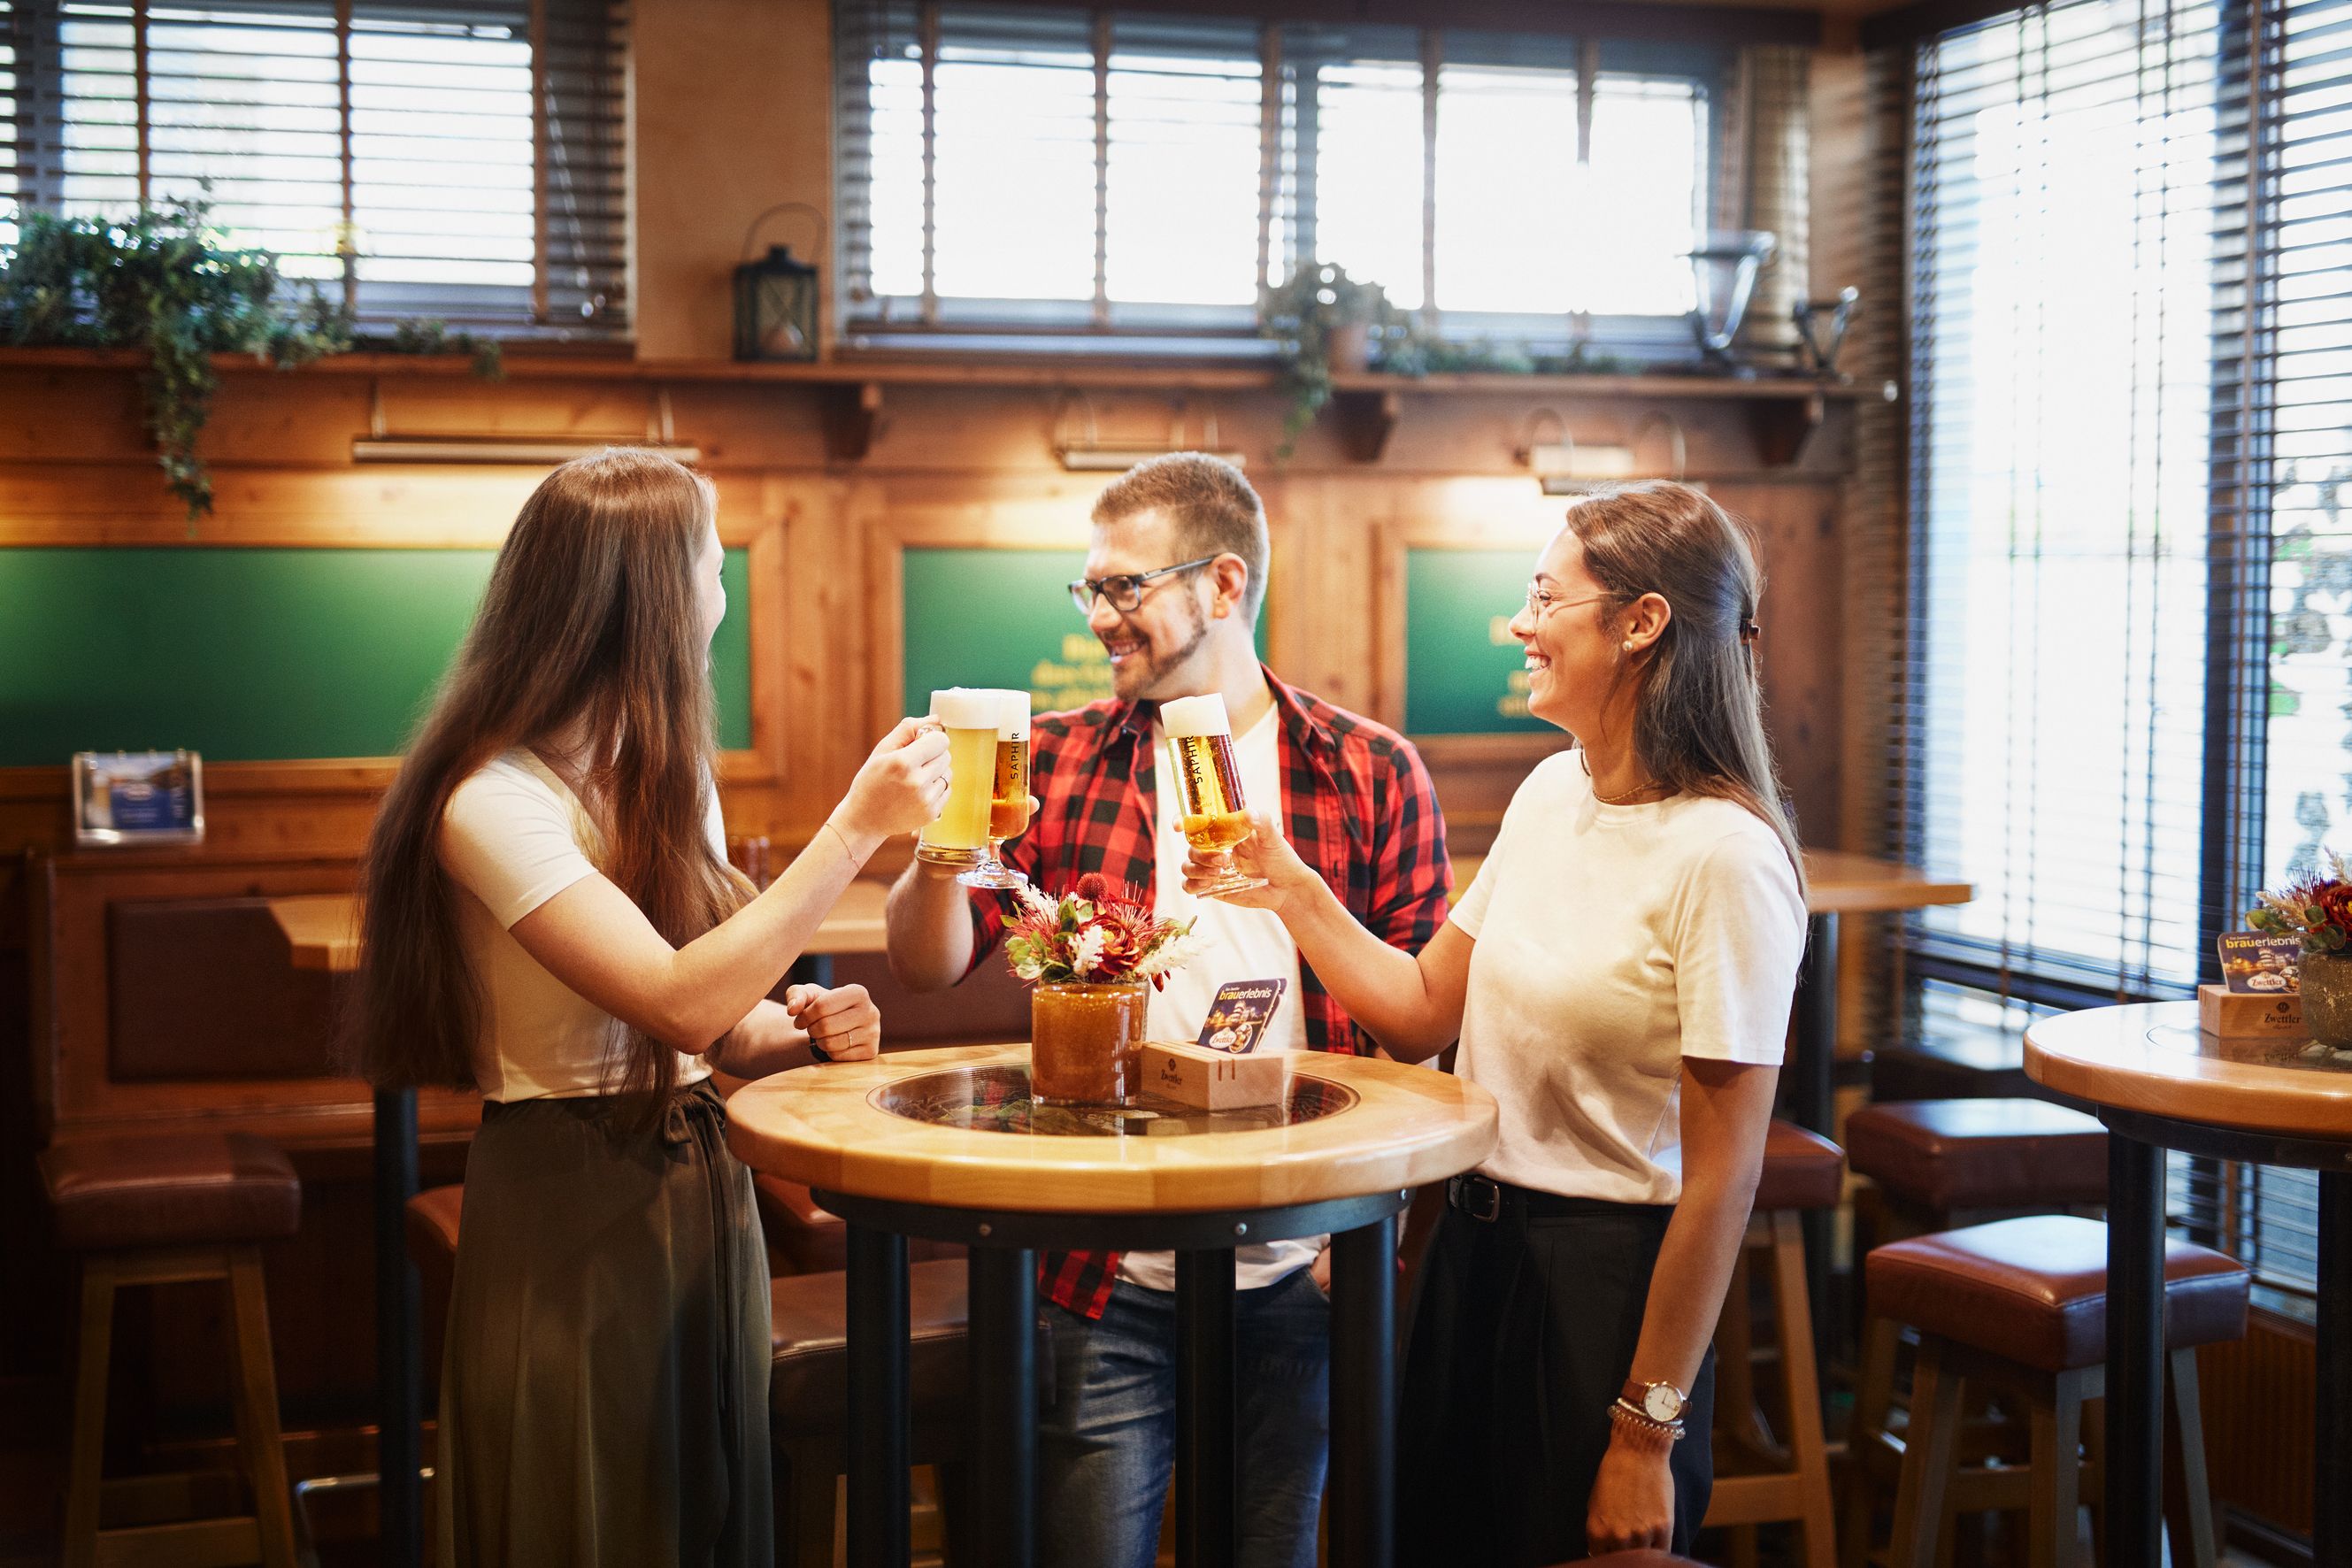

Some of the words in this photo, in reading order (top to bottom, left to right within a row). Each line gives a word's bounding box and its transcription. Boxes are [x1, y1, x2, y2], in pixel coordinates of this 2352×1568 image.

[1011, 732, 1020, 780] SAPHIR
[1186, 735, 1203, 785] SAPHIR
[2225, 935, 2301, 949] brauerlebnis
[1218, 987, 1272, 1001] brauerlebnis
[2264, 1012, 2301, 1024] Zwettler
